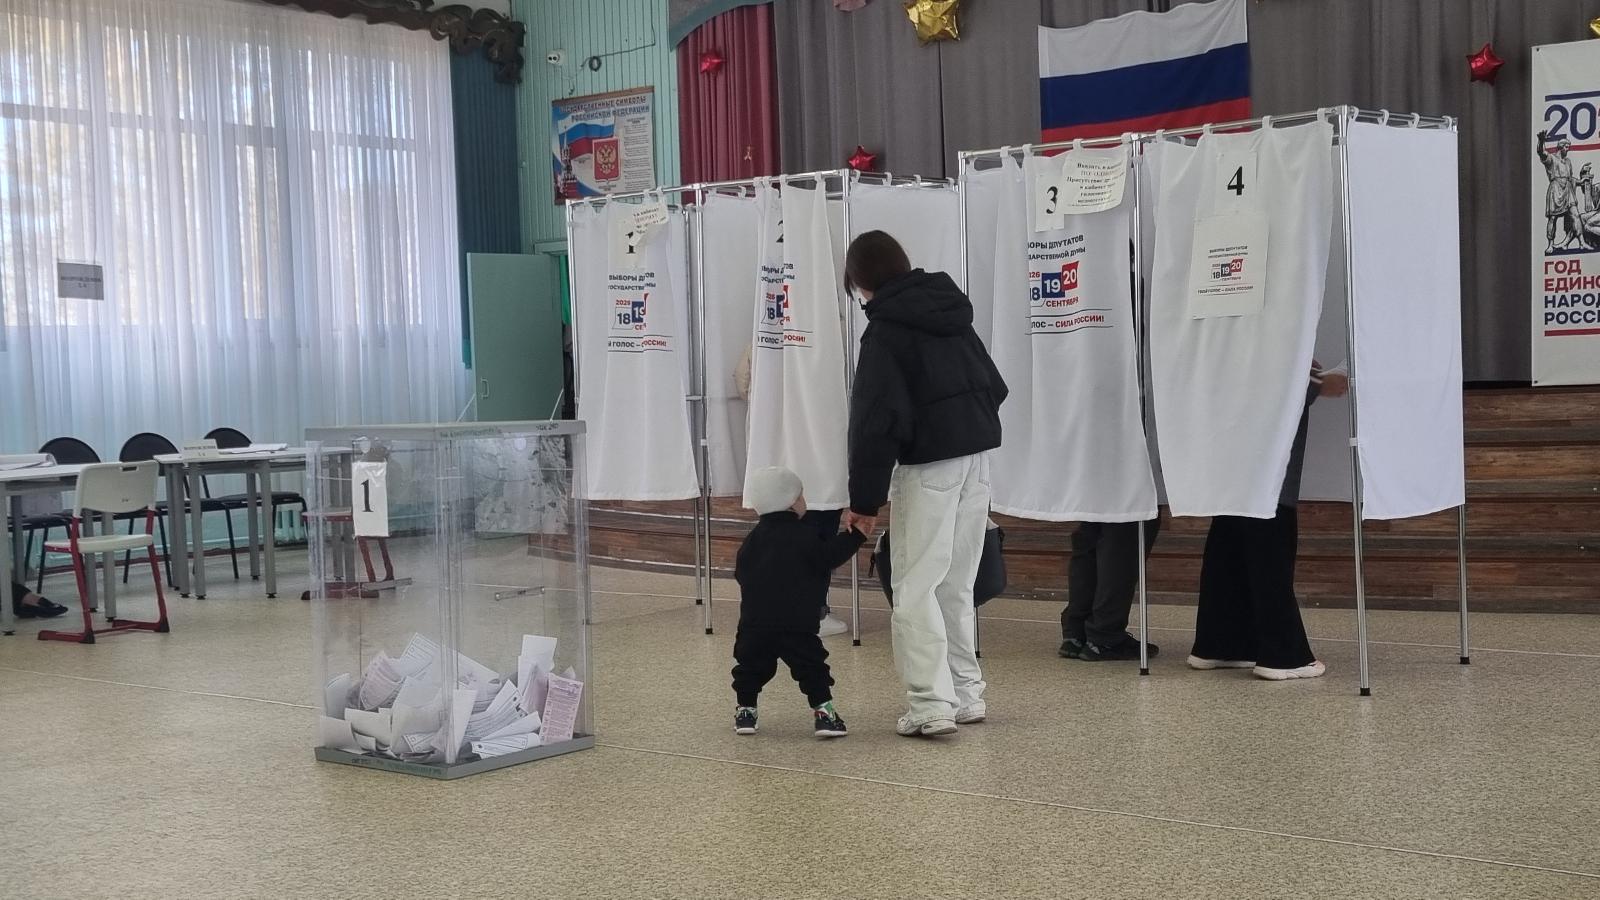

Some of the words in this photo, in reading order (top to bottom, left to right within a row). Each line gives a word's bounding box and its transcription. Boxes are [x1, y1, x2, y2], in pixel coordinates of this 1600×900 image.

[1544, 102, 1600, 142] 20
[1227, 165, 1245, 196] 4
[1046, 185, 1058, 214] 3
[1028, 241, 1047, 249] ОРЫ
[1212, 271, 1221, 279] 18
[1222, 267, 1230, 275] 19
[1231, 261, 1241, 270] 20
[1544, 260, 1581, 275] ГОД
[1043, 278, 1061, 294] 19
[1062, 268, 1077, 285] 20
[617, 312, 631, 325] 18
[1055, 318, 1074, 329] СИЛА
[1074, 314, 1105, 326] РОССИИ!
[360, 479, 374, 512] 1
